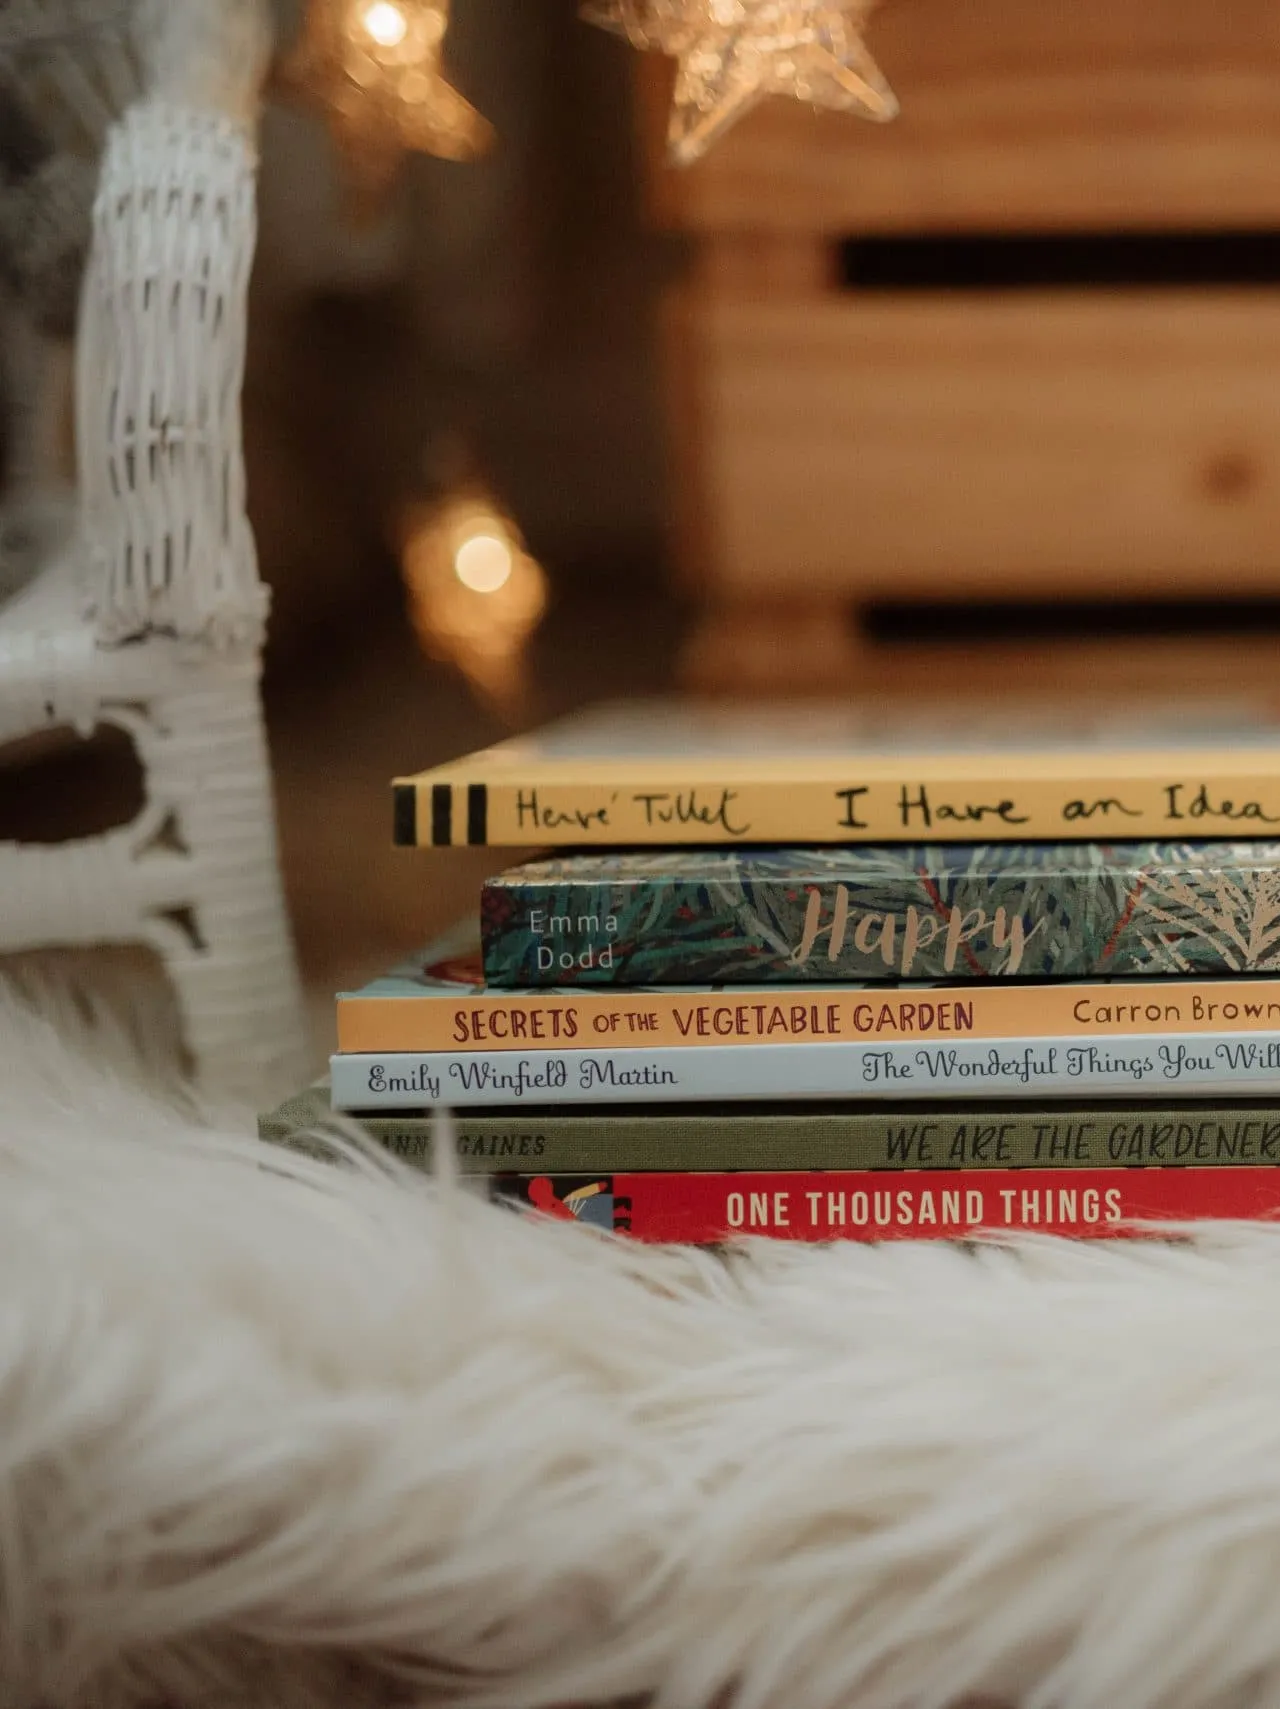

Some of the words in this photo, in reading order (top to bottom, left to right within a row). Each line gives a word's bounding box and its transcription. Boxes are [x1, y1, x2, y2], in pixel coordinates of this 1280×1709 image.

[516, 788, 619, 831] Hervé
[632, 788, 751, 835] Tullet
[836, 786, 869, 829] I
[898, 784, 1031, 828] Have
[1063, 799, 1143, 821] an
[529, 909, 618, 934] Emma
[788, 884, 1047, 976] Happy
[537, 944, 613, 970] Dodd
[453, 1008, 578, 1043] SECRETS
[592, 1014, 622, 1034] OF
[624, 1012, 660, 1032] THE
[672, 1004, 841, 1037] VEGETABLE
[852, 1001, 974, 1033] GARDEN
[1073, 1000, 1180, 1024] Carron
[368, 1064, 440, 1099] Emily
[449, 1059, 568, 1097] Winfield
[580, 1058, 679, 1089] Martin
[862, 1051, 914, 1082] The
[915, 1047, 1060, 1083] Wonderful
[1066, 1046, 1154, 1080] Things
[1158, 1045, 1215, 1078] You
[457, 1134, 547, 1156] GAINES
[886, 1124, 938, 1162] WE
[950, 1124, 1018, 1162] ARE
[1032, 1123, 1096, 1160] THE
[727, 1192, 790, 1226] ONE
[806, 1190, 984, 1226] THOUSAND
[1000, 1189, 1122, 1224] THINGS
